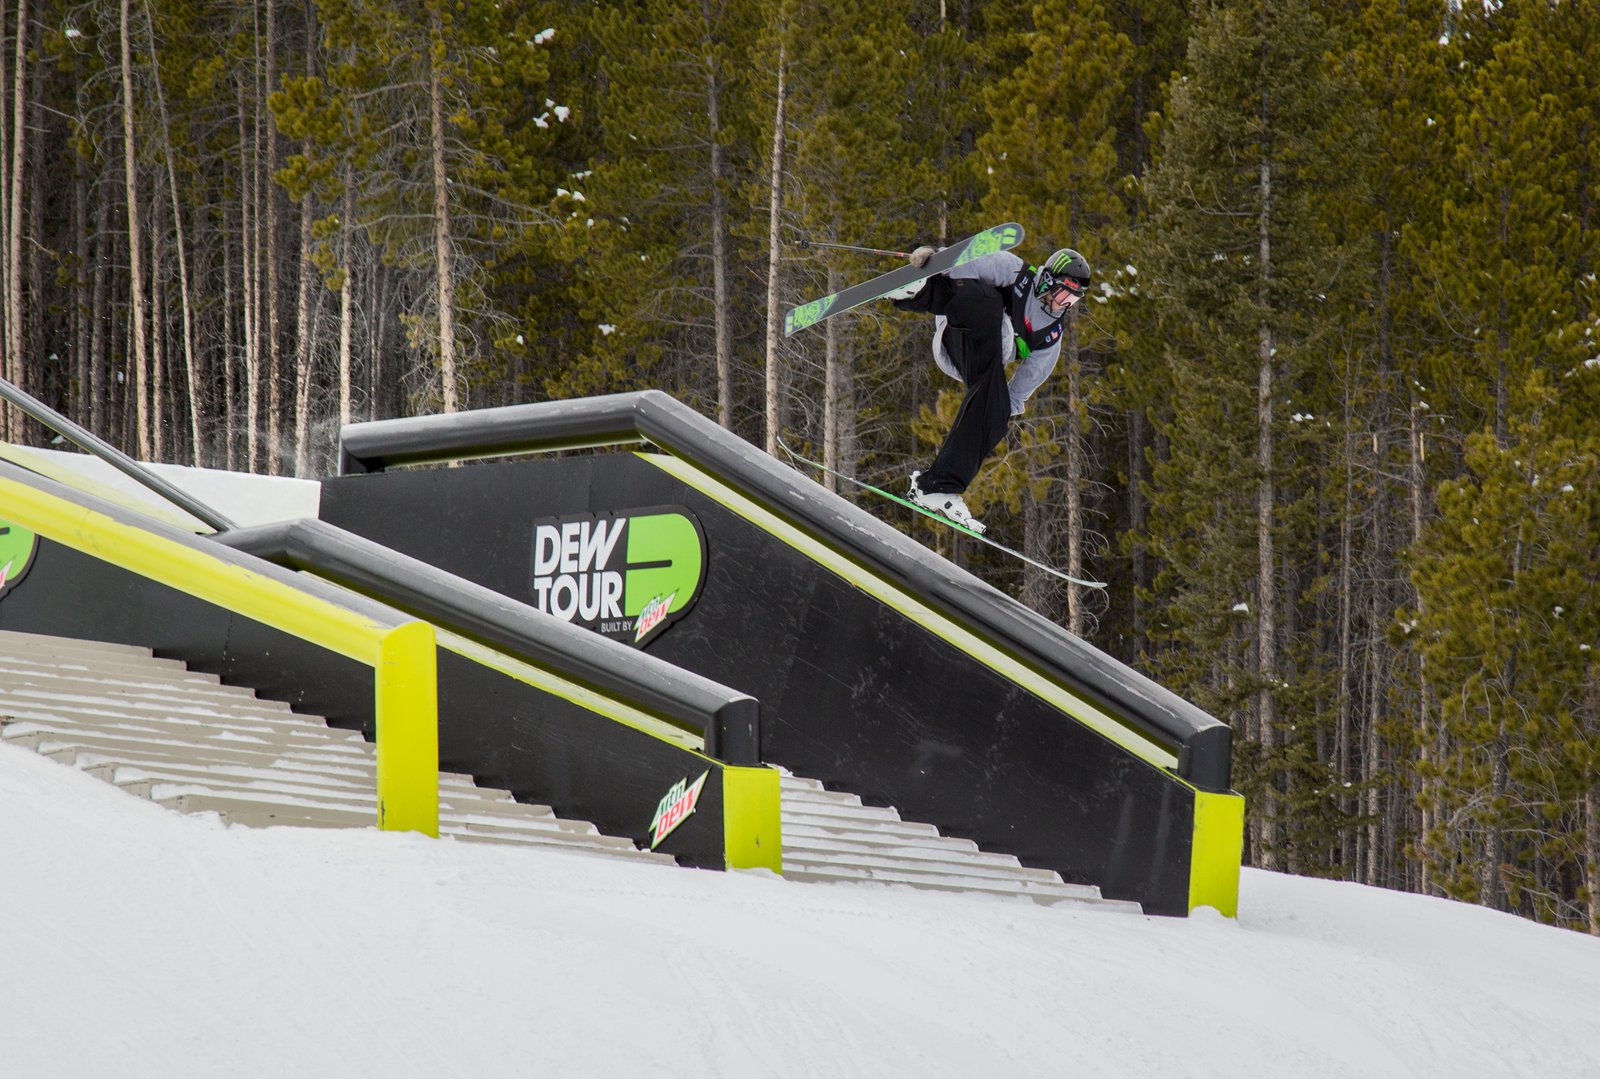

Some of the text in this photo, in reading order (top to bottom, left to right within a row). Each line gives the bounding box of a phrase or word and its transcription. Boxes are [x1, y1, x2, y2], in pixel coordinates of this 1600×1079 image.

[535, 518, 627, 576] DEW
[534, 571, 623, 622] TOUR
[601, 621, 632, 633] BUILT BY
